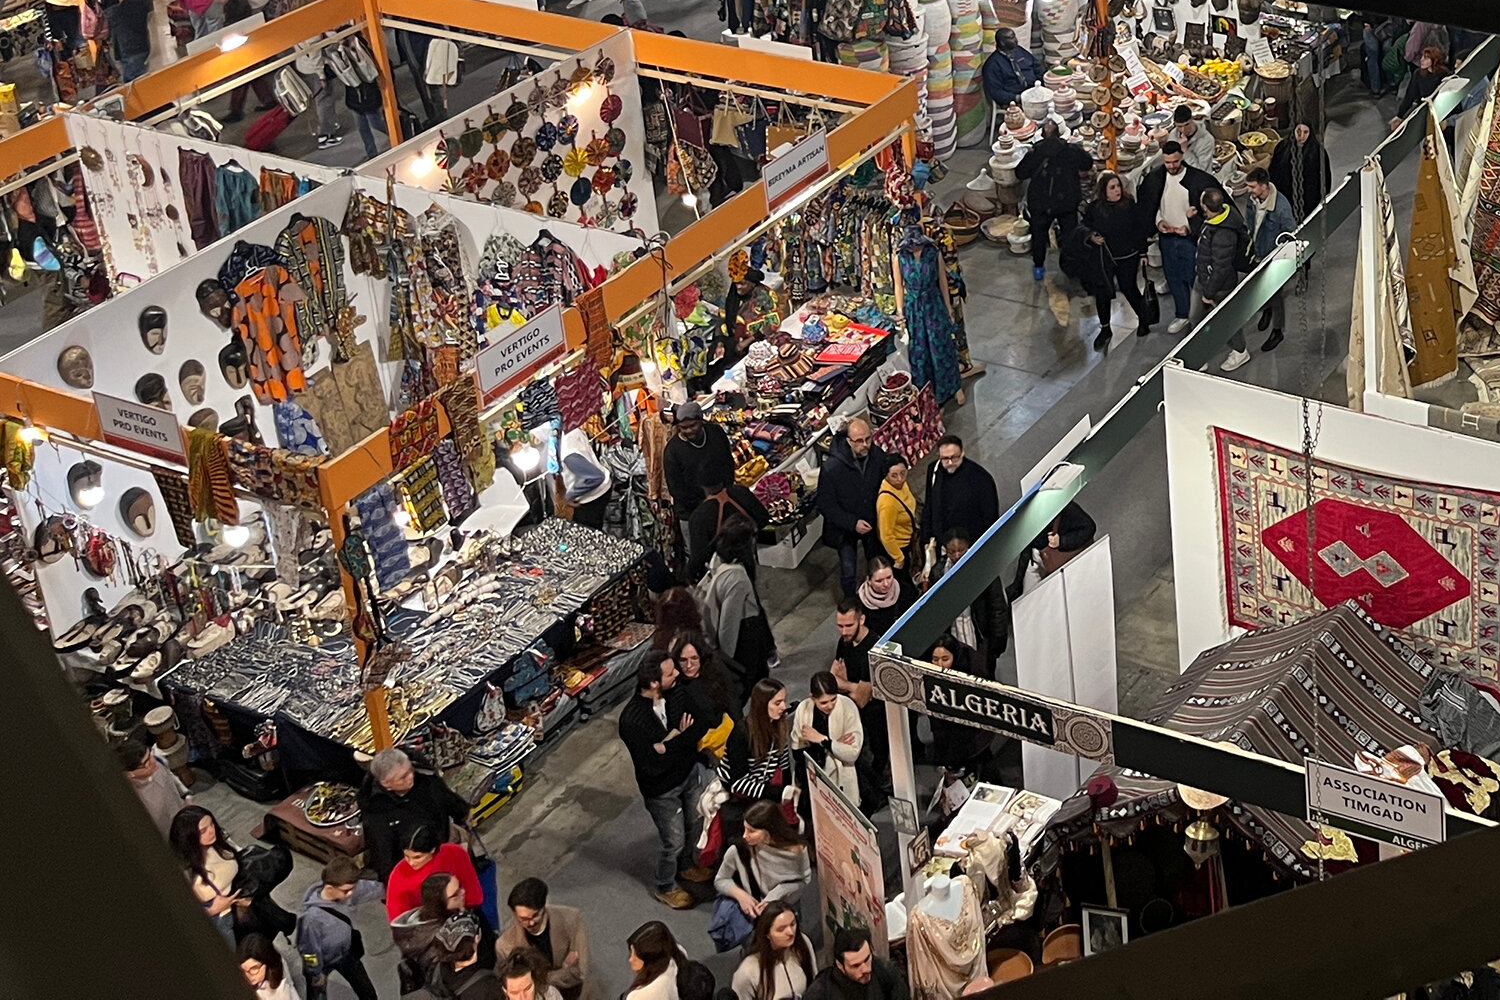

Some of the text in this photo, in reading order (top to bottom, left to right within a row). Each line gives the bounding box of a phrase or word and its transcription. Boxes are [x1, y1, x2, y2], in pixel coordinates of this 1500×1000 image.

[494, 333, 551, 377] PRO EVENTS
[500, 327, 540, 358] VERTIGO
[112, 418, 169, 442] PRO EVENTS
[116, 408, 157, 427] VERTIGO
[929, 684, 1050, 737] ALGERIA
[1322, 776, 1427, 815] ASSOCIATION
[1341, 795, 1404, 823] TIMGAD
